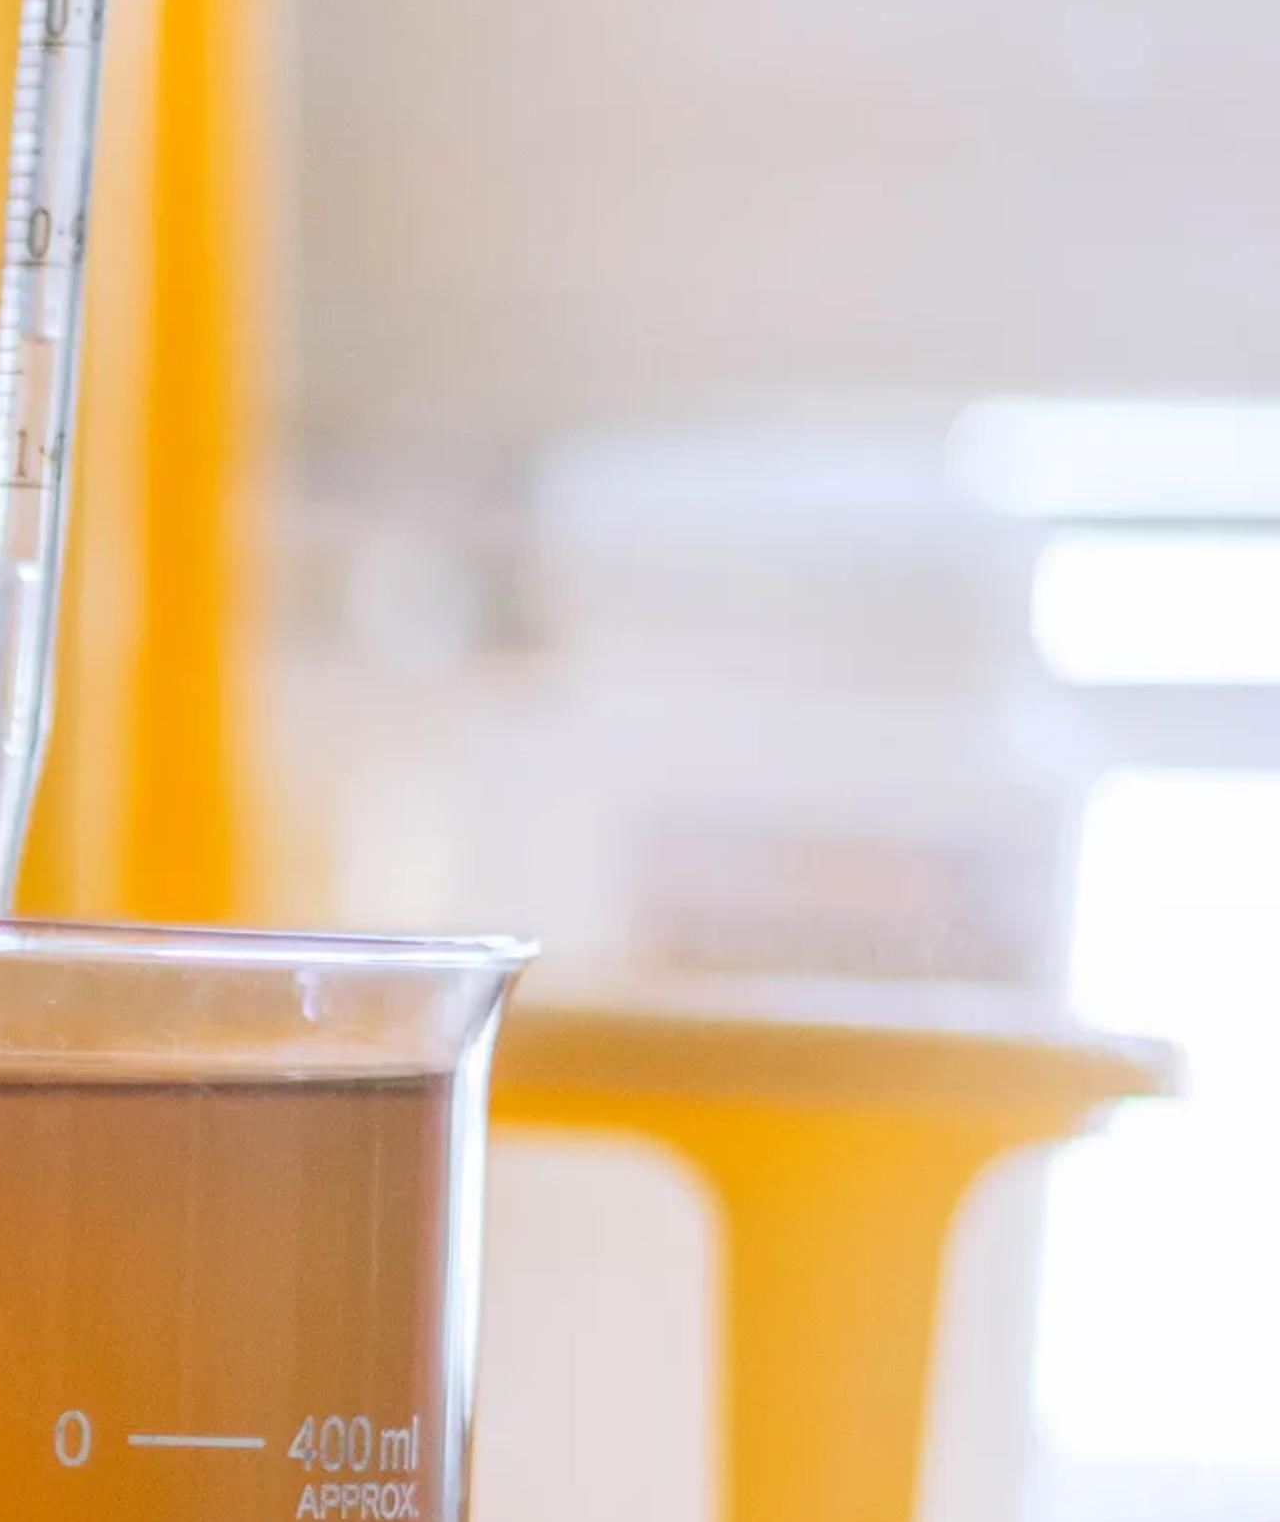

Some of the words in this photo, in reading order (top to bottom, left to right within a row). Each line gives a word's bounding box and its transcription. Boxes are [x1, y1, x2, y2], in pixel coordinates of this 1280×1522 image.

[53, 1409, 93, 1468] 0
[287, 1414, 372, 1472] 400
[380, 1414, 420, 1471] ml
